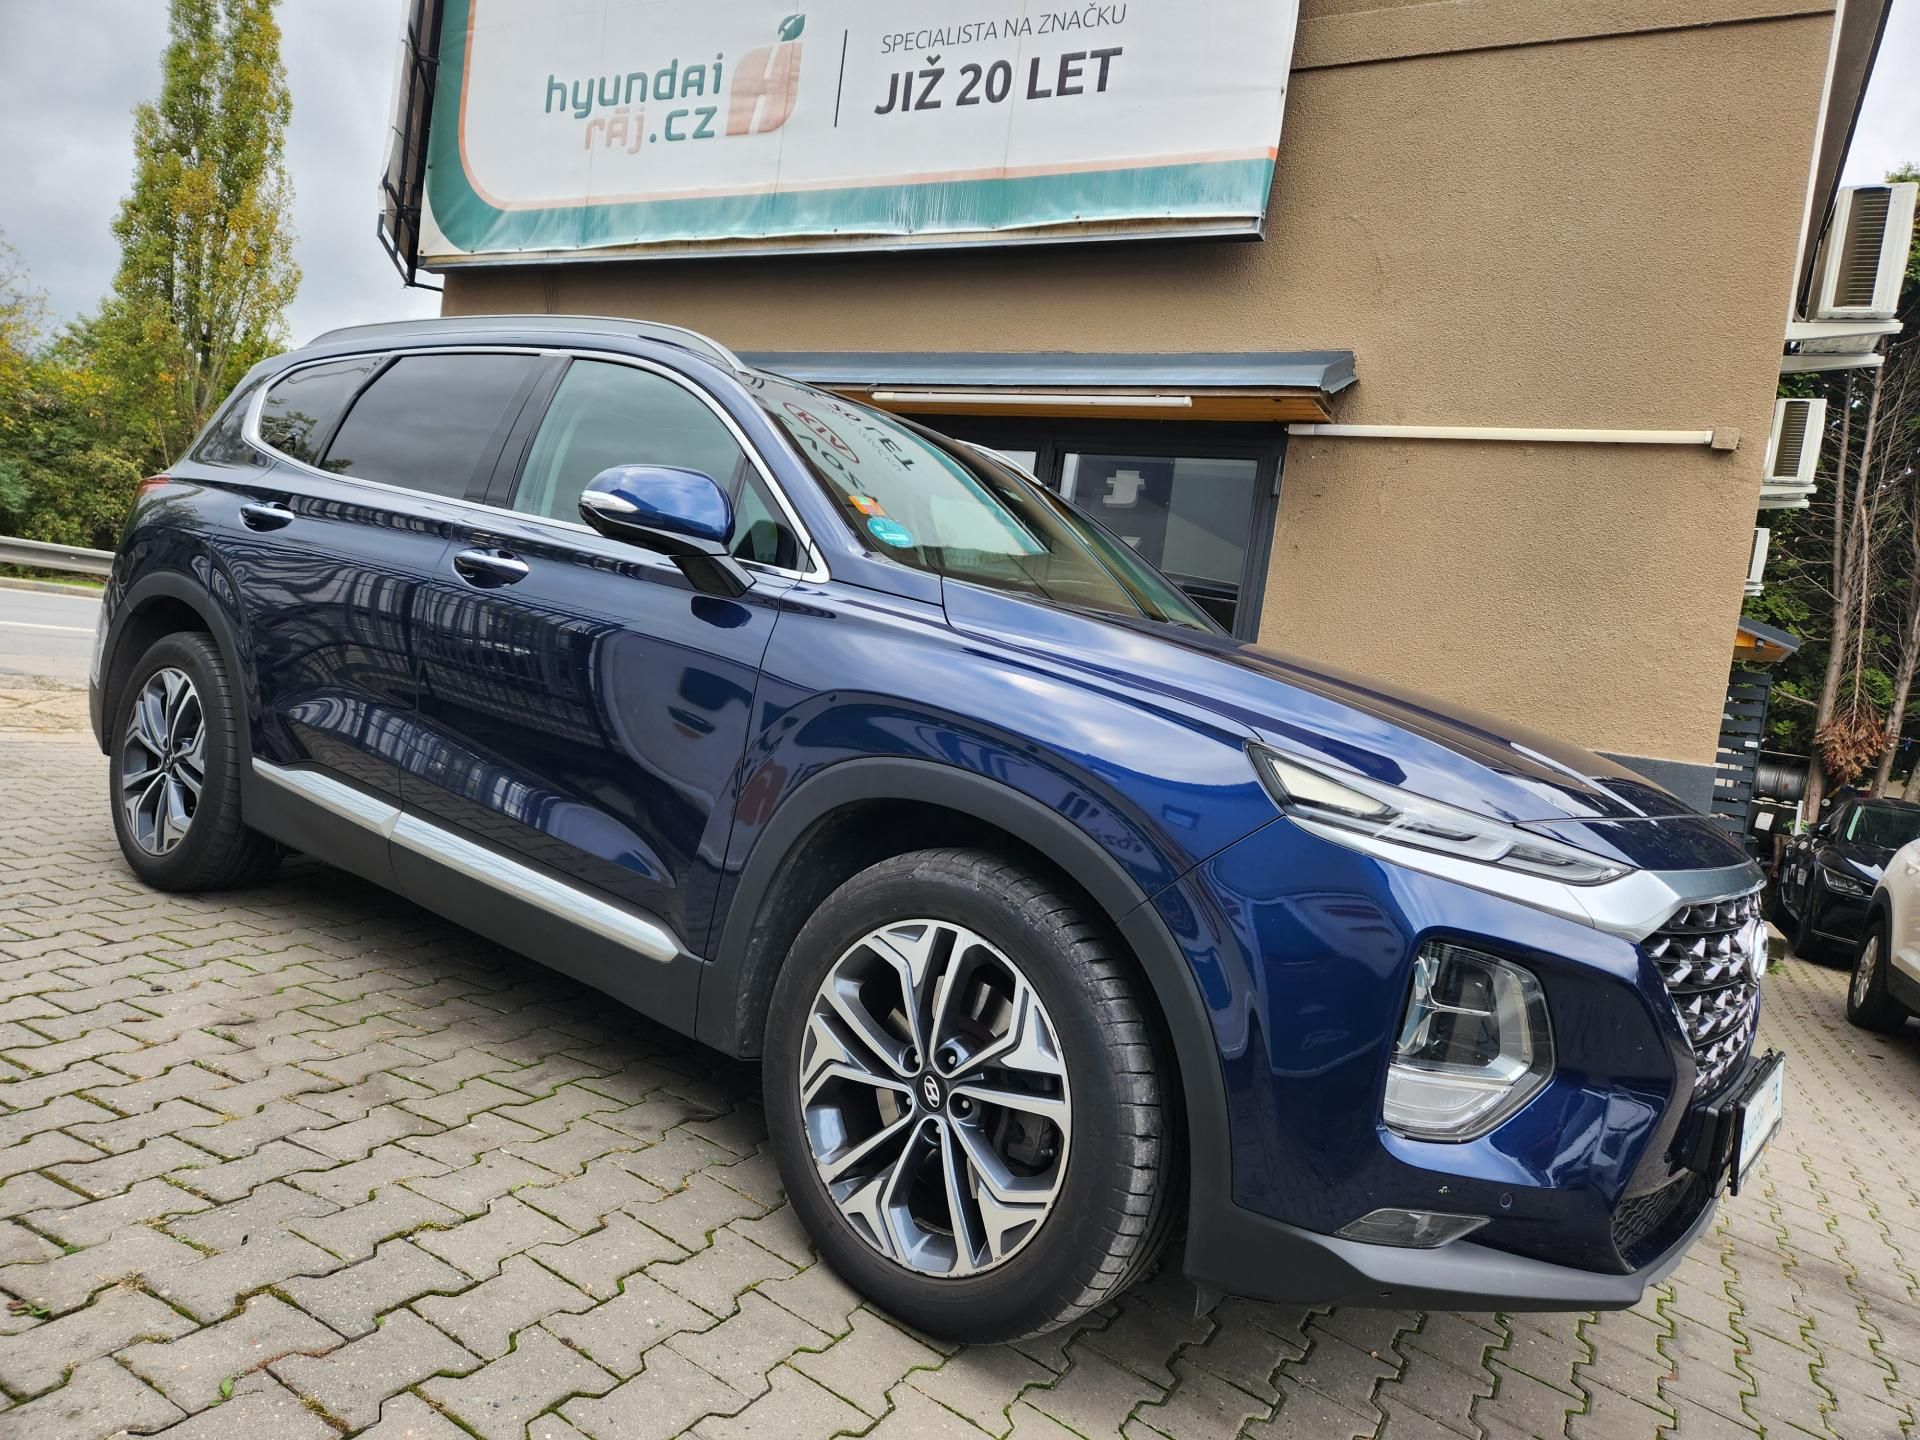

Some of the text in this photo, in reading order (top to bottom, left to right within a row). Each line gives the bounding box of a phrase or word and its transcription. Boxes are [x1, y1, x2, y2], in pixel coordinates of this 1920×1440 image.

[881, 2, 1127, 54] SPECIALISTA NA ZNAČKU
[545, 52, 724, 119] hyundai
[874, 46, 1124, 115] JIŽ 20 LET
